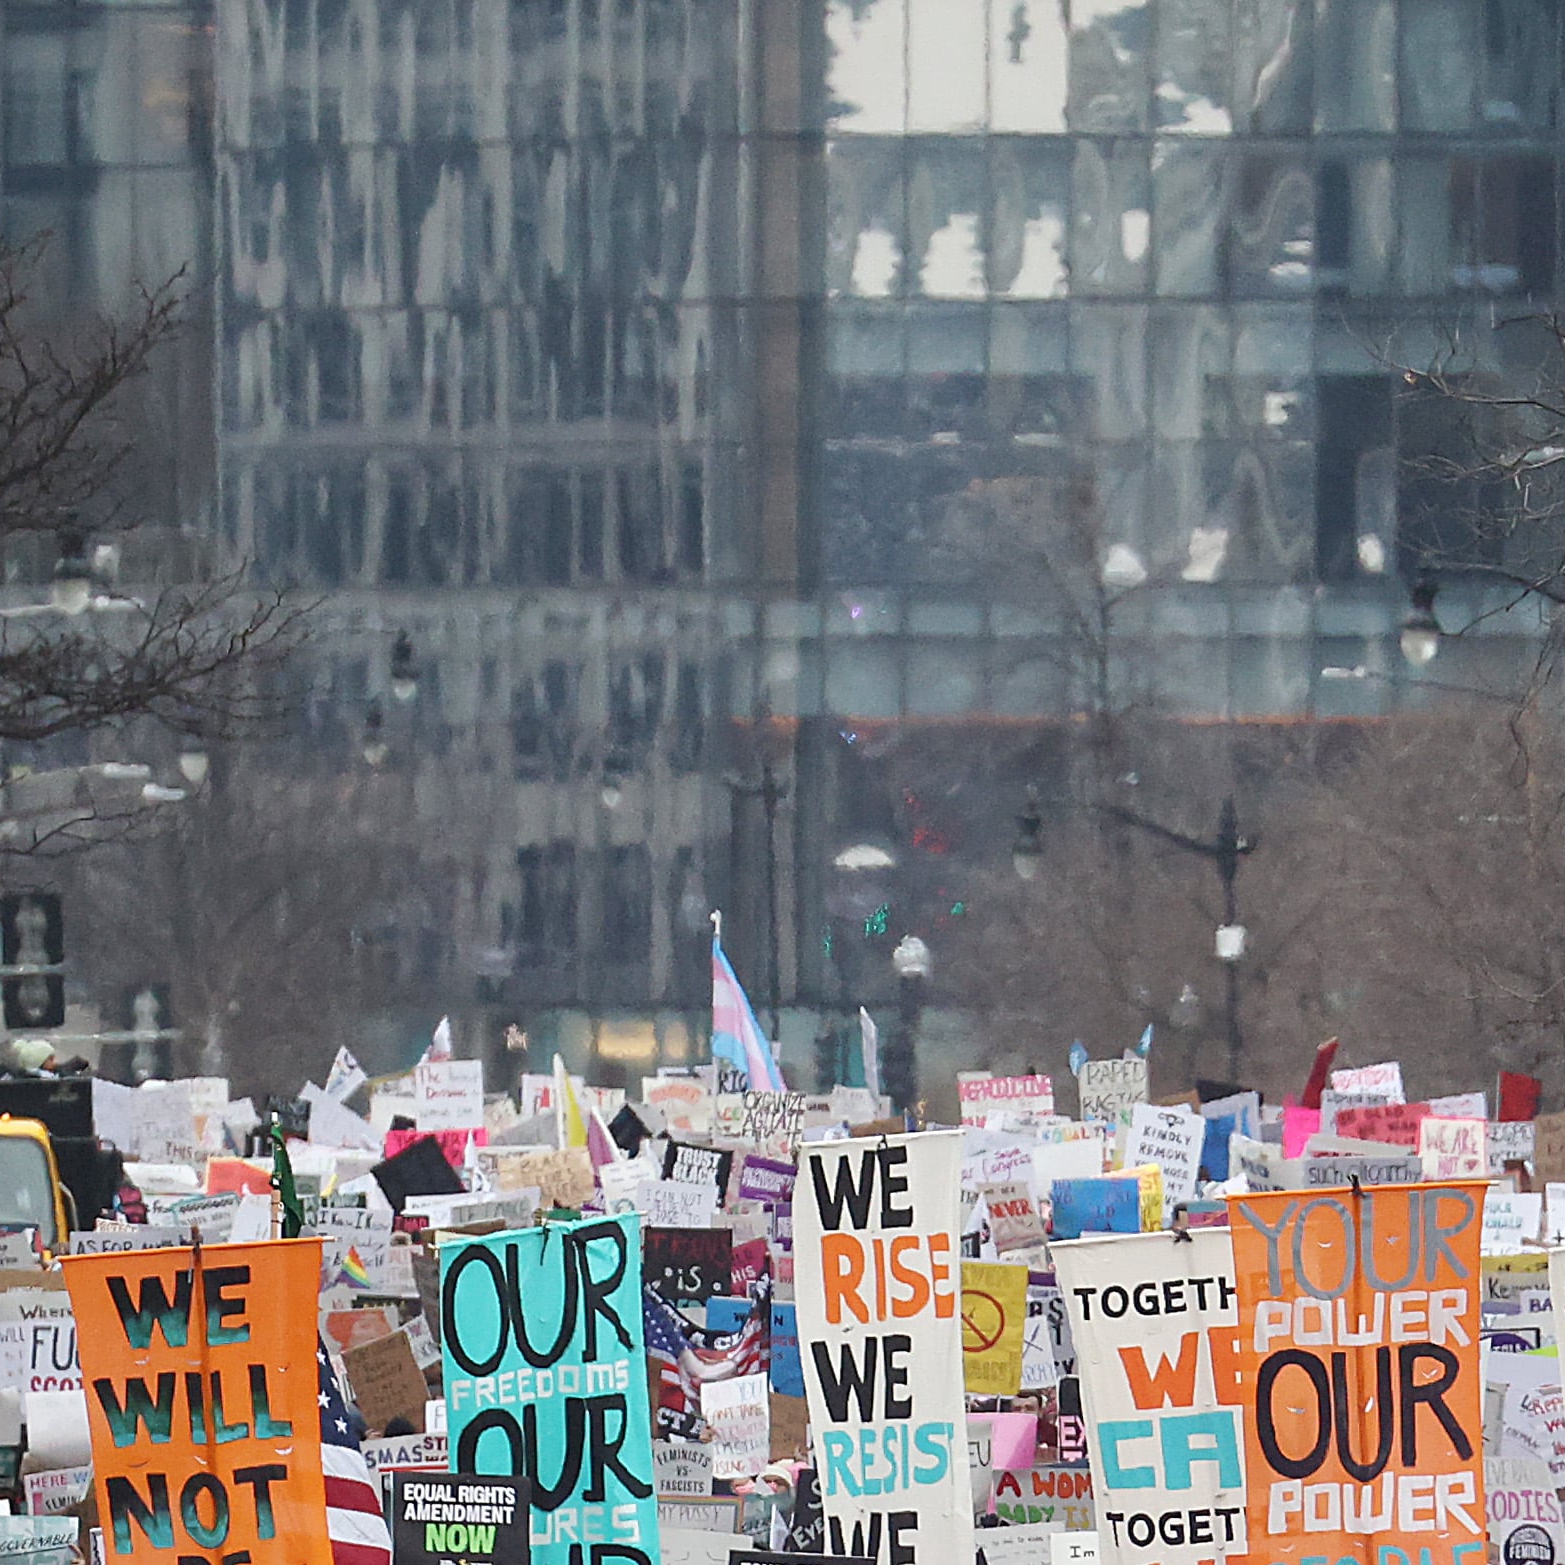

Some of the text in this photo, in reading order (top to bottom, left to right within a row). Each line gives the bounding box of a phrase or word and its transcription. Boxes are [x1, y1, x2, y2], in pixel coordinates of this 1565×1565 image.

[742, 1111, 804, 1130] AGITATE
[745, 1092, 806, 1110] ORGANIZE
[1138, 1142, 1189, 1163] REMOVE
[1143, 1125, 1193, 1145] KINDLY
[676, 1147, 721, 1168] TRUST
[809, 1146, 913, 1231] WE
[988, 1199, 1034, 1219] NEVER
[1239, 1188, 1476, 1300] YOUR
[441, 1224, 633, 1376] OUR
[820, 1232, 955, 1325] RISE
[1073, 1277, 1236, 1321] TOGETH
[106, 1266, 251, 1349] WE
[1254, 1289, 1472, 1353] POWER
[31, 1325, 81, 1371] FU
[451, 1359, 629, 1410] FREEDOMS
[810, 1335, 912, 1423] WE
[93, 1364, 293, 1448] WILL
[1256, 1341, 1473, 1482] OUR
[457, 1393, 653, 1512] OUR
[656, 1448, 711, 1468] FEMINISTS
[1098, 1411, 1242, 1490] CA
[403, 1483, 516, 1505] EQUAL RIGHTS
[660, 1480, 705, 1493] FASCISTS
[996, 1472, 1022, 1498] A
[1268, 1471, 1482, 1535] POWER
[106, 1465, 288, 1555] NOT
[404, 1503, 515, 1525] AMENDMENT
[530, 1504, 641, 1546] URES
[1063, 1506, 1090, 1528] IS
[425, 1523, 496, 1554] NOW
[1070, 1546, 1095, 1559] Im
